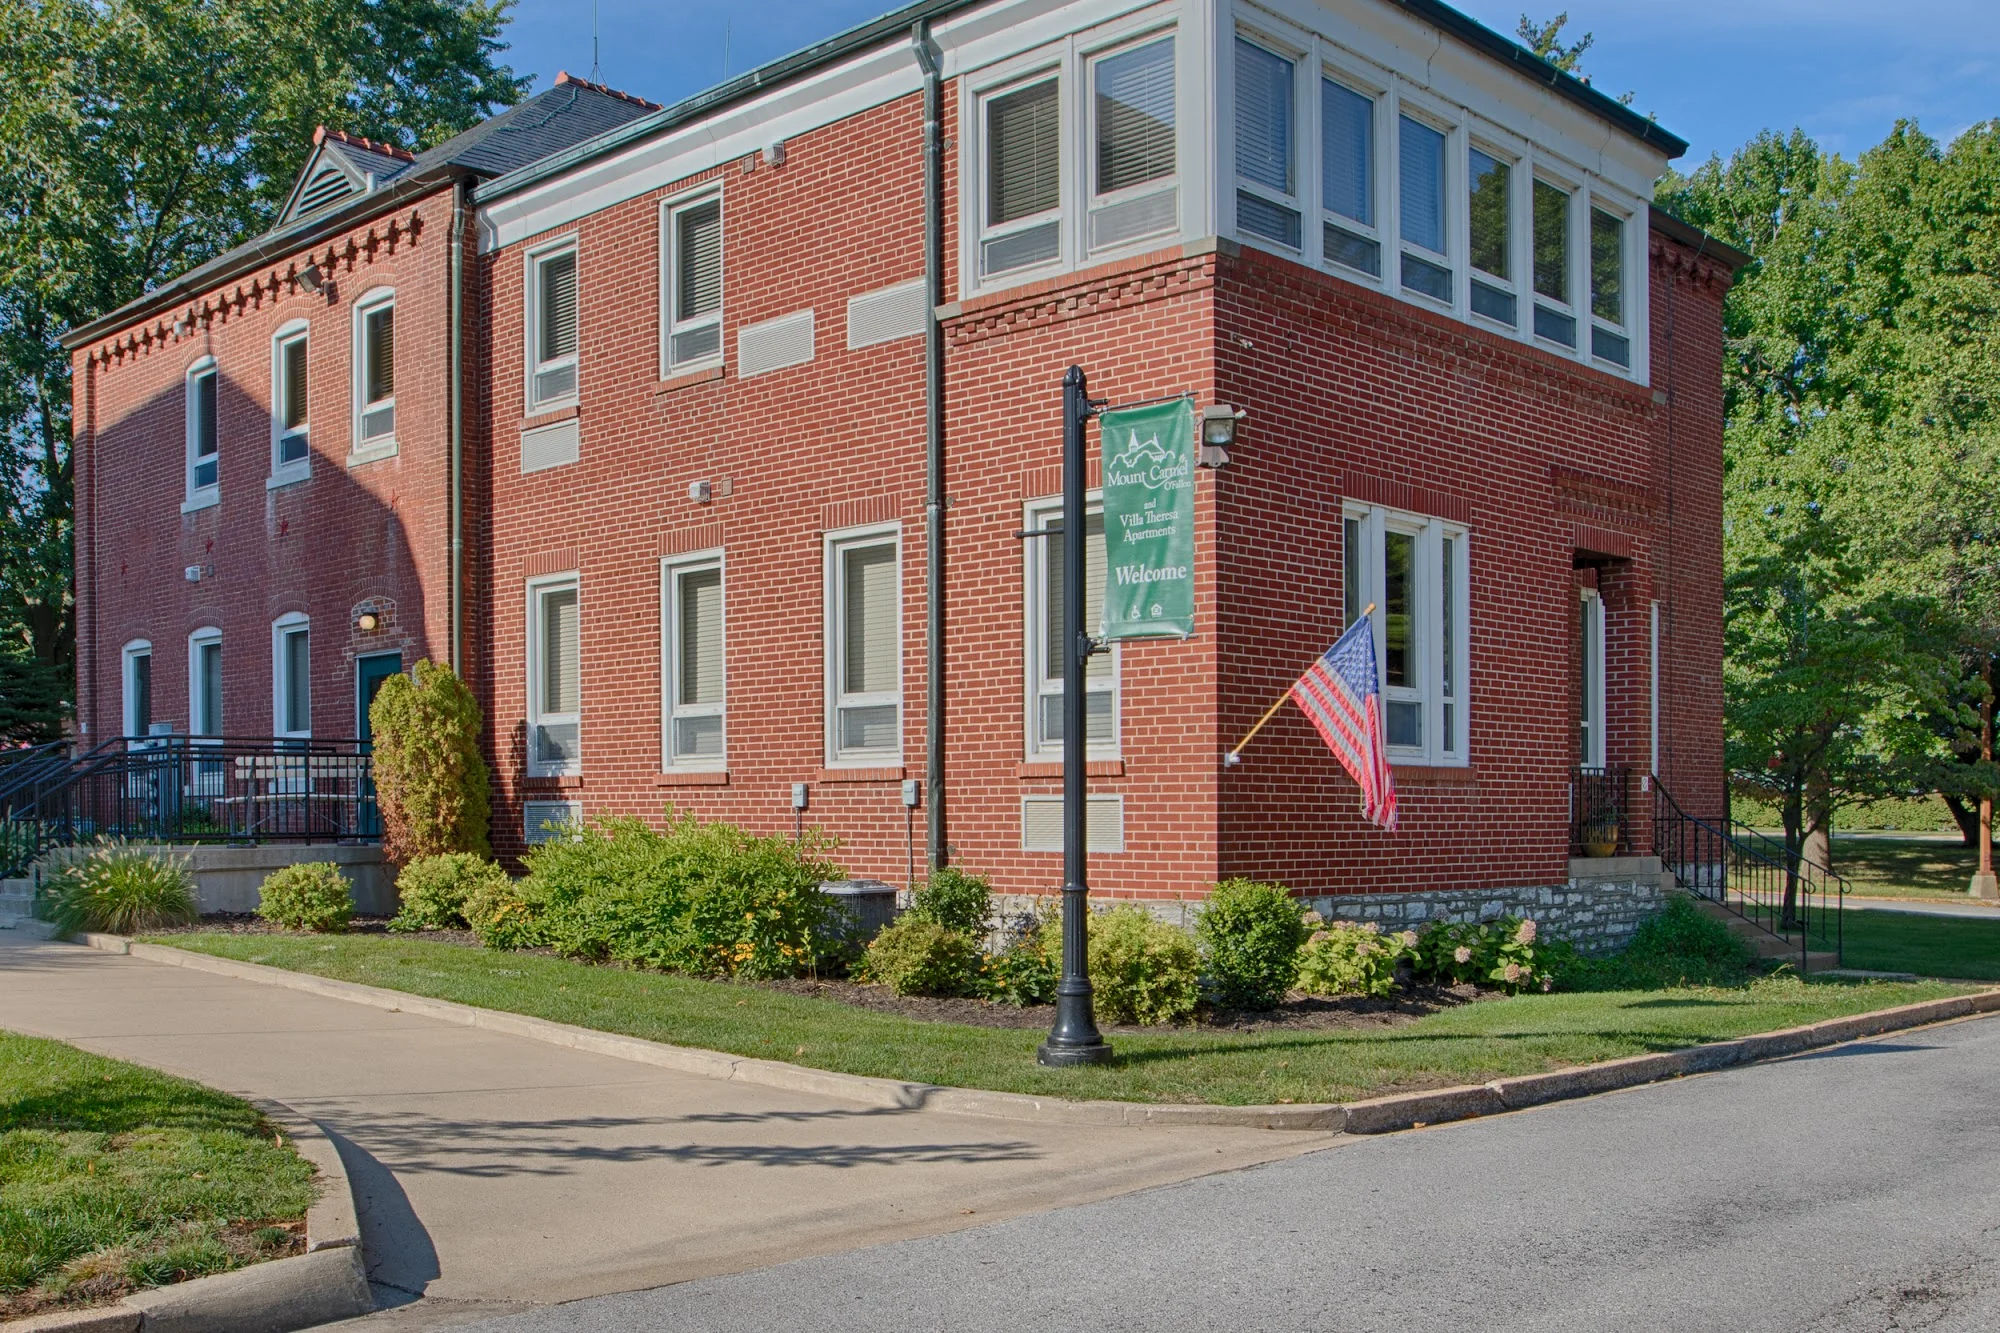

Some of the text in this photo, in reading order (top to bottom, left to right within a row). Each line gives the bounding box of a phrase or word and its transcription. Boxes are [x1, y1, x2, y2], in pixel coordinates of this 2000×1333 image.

[1107, 459, 1188, 488] Mount Carmel
[1164, 480, 1191, 491] O'Fallon
[1144, 498, 1156, 510] and
[1120, 510, 1178, 527] Villa Theresa
[1123, 525, 1176, 544] Apartments
[1116, 563, 1187, 586] Welcome
